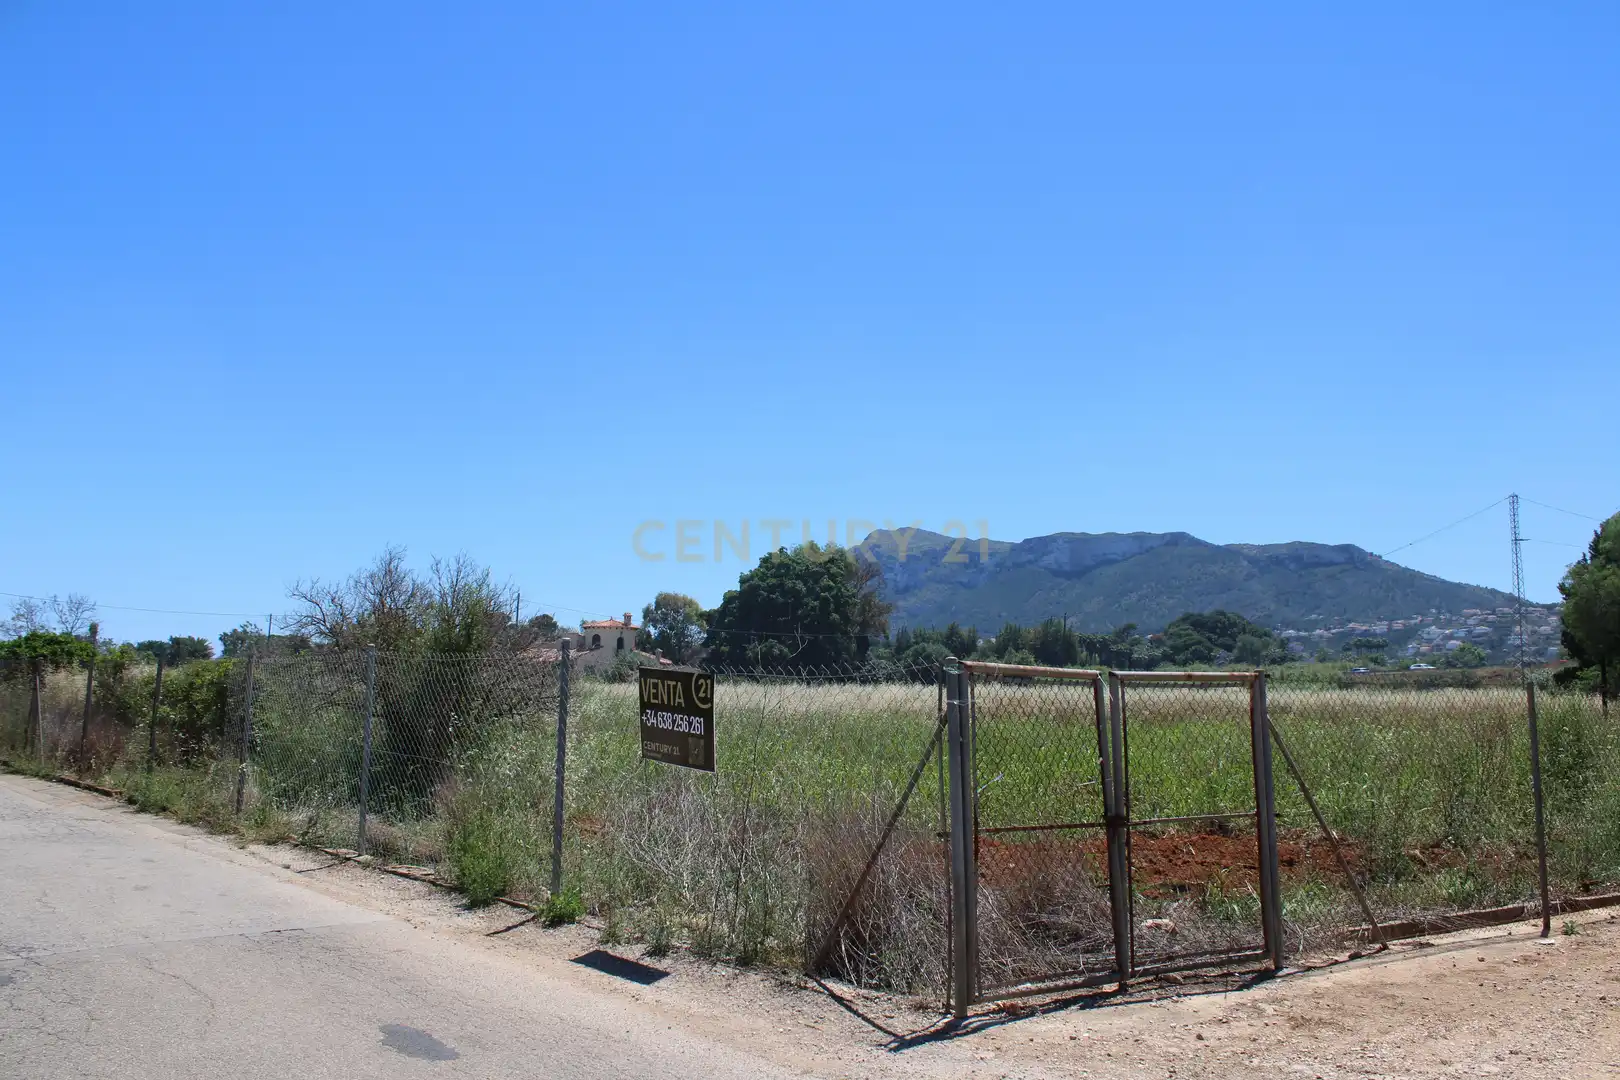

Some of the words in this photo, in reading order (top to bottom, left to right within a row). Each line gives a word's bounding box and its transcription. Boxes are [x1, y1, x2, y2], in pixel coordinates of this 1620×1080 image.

[641, 678, 685, 708] VENTA
[641, 709, 657, 728] +34
[657, 711, 673, 730] 638
[673, 713, 689, 733] 256
[689, 716, 704, 735] 261
[643, 741, 672, 754] CENTURY
[673, 746, 680, 756] 21
